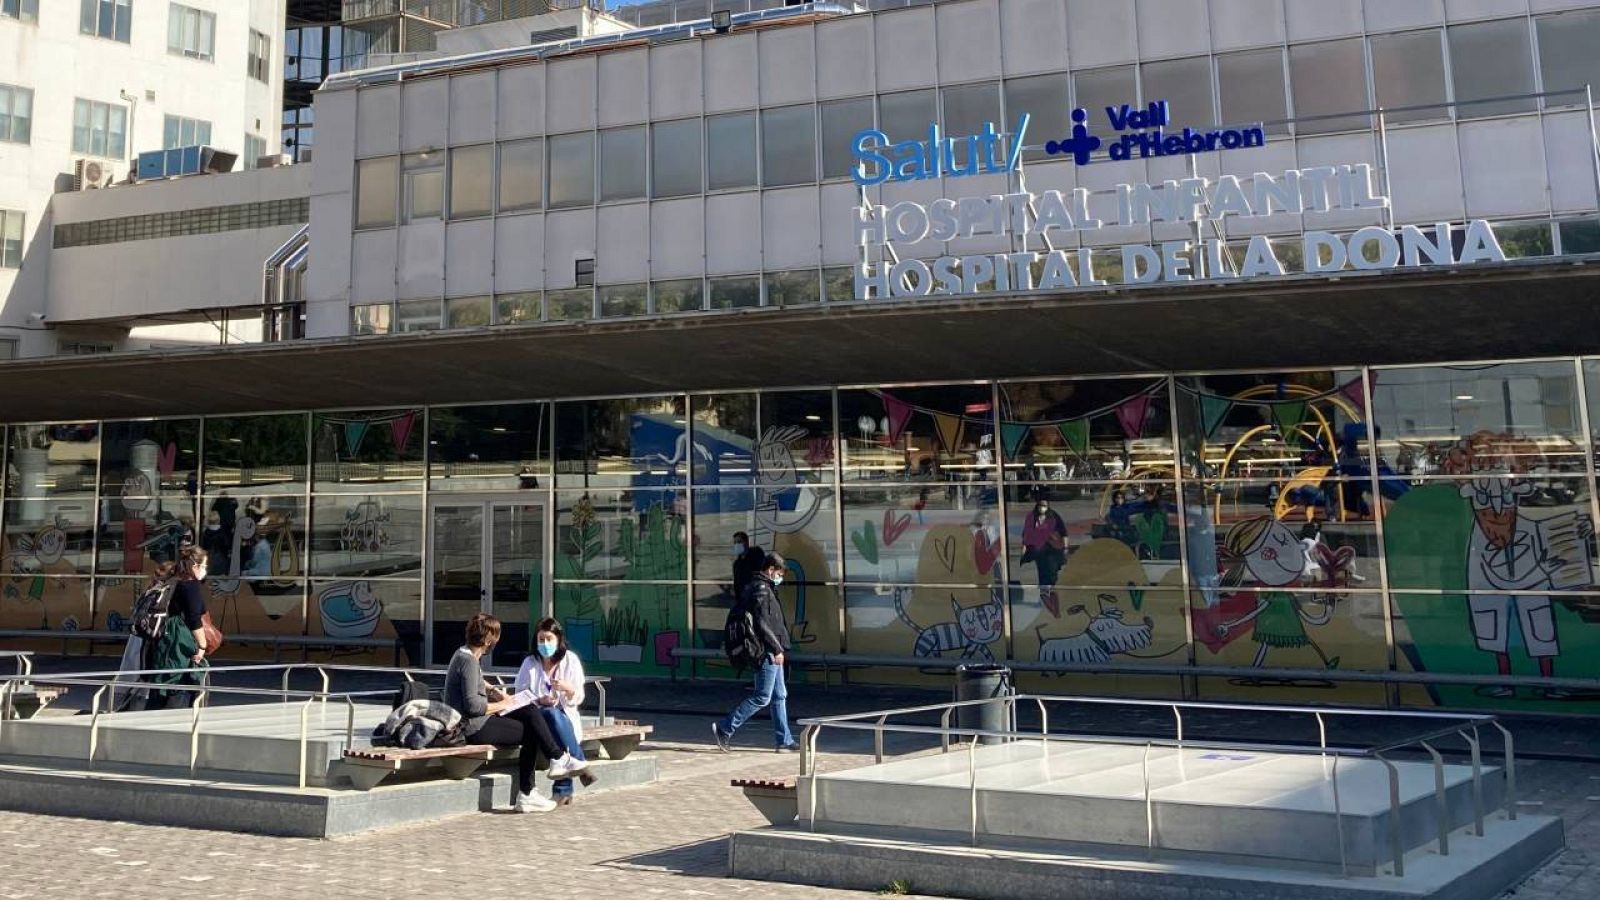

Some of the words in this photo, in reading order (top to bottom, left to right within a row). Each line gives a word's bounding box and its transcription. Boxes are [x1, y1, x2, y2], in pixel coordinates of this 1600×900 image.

[1106, 100, 1169, 131] Vall
[1109, 122, 1265, 161] d'Hebron
[852, 187, 1103, 245] HOSPITAL
[1116, 163, 1390, 227] INFANTIL
[854, 247, 1108, 301] HOSPITAL
[1122, 240, 1197, 286] DE
[1207, 233, 1286, 278] LA
[1304, 218, 1507, 273] DONA
